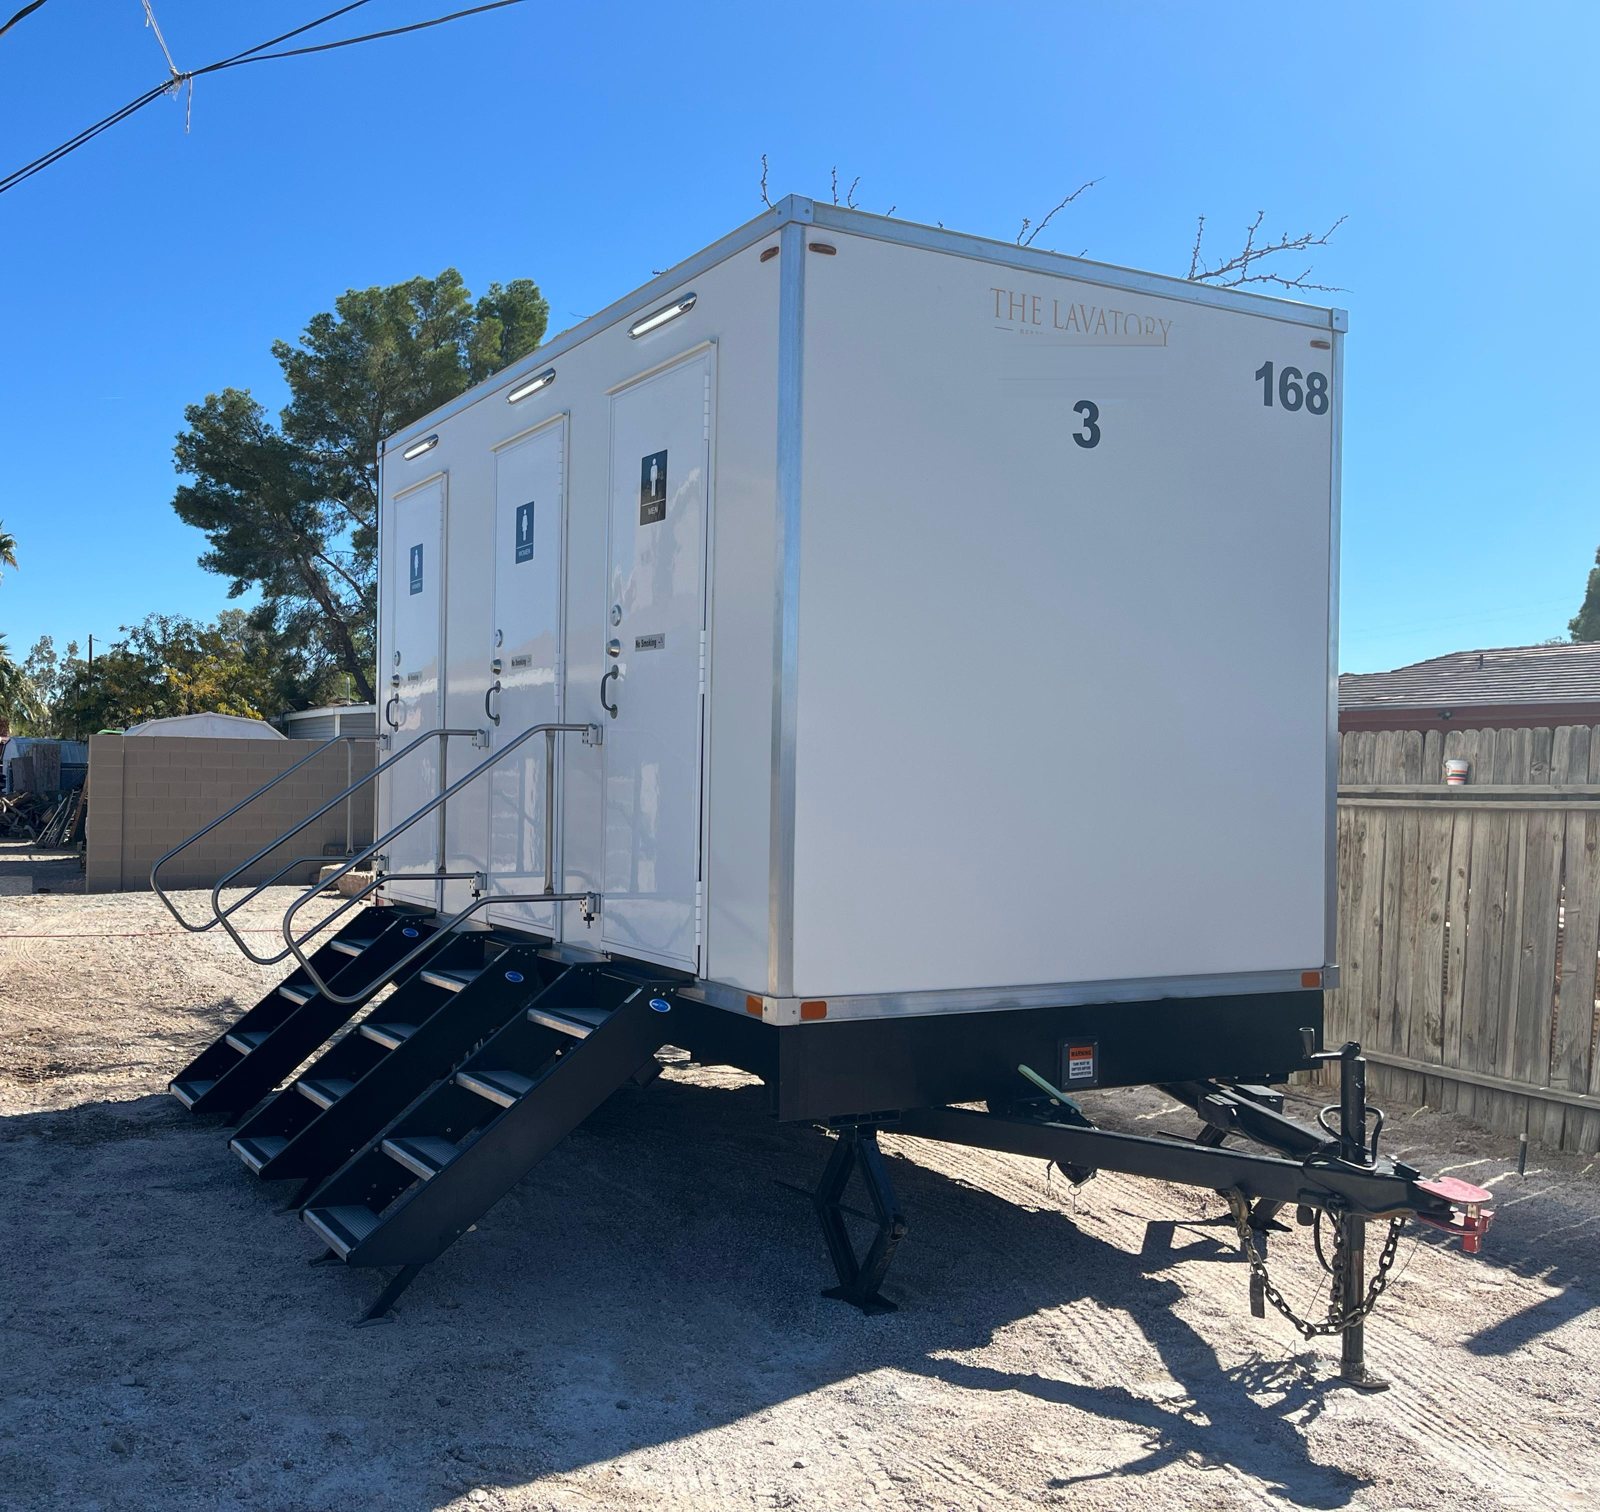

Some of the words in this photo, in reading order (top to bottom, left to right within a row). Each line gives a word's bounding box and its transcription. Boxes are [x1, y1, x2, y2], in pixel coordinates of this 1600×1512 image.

[990, 287, 1042, 325] THE
[1053, 299, 1173, 347] LAVATORY
[1254, 360, 1330, 415] 168
[1072, 399, 1101, 448] 3
[641, 637, 657, 648] Smoking
